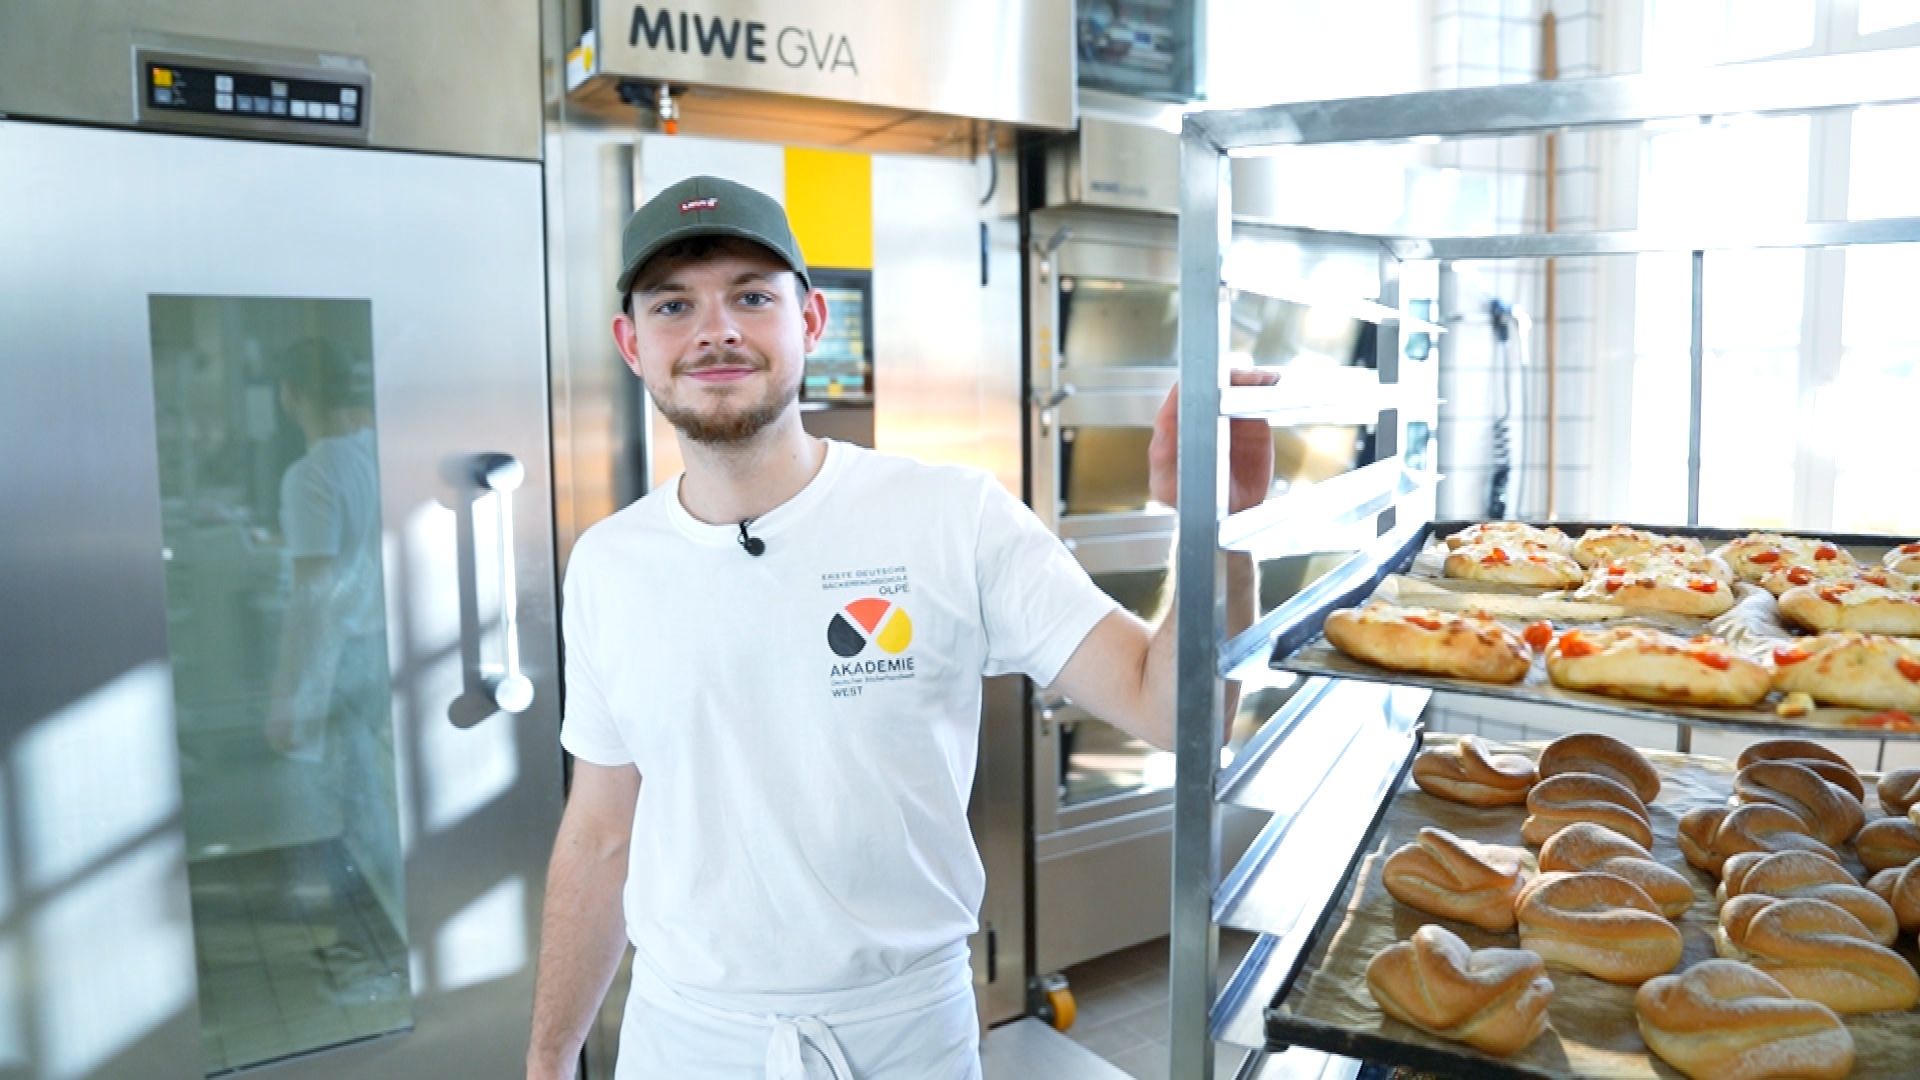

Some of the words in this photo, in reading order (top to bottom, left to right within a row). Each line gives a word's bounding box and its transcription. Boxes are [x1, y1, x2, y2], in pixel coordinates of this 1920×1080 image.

[629, 4, 767, 63] MIWE
[776, 26, 859, 76] GVA
[878, 583, 910, 596] OLPE
[830, 657, 915, 677] AKADEMIE
[832, 686, 863, 698] WEST
